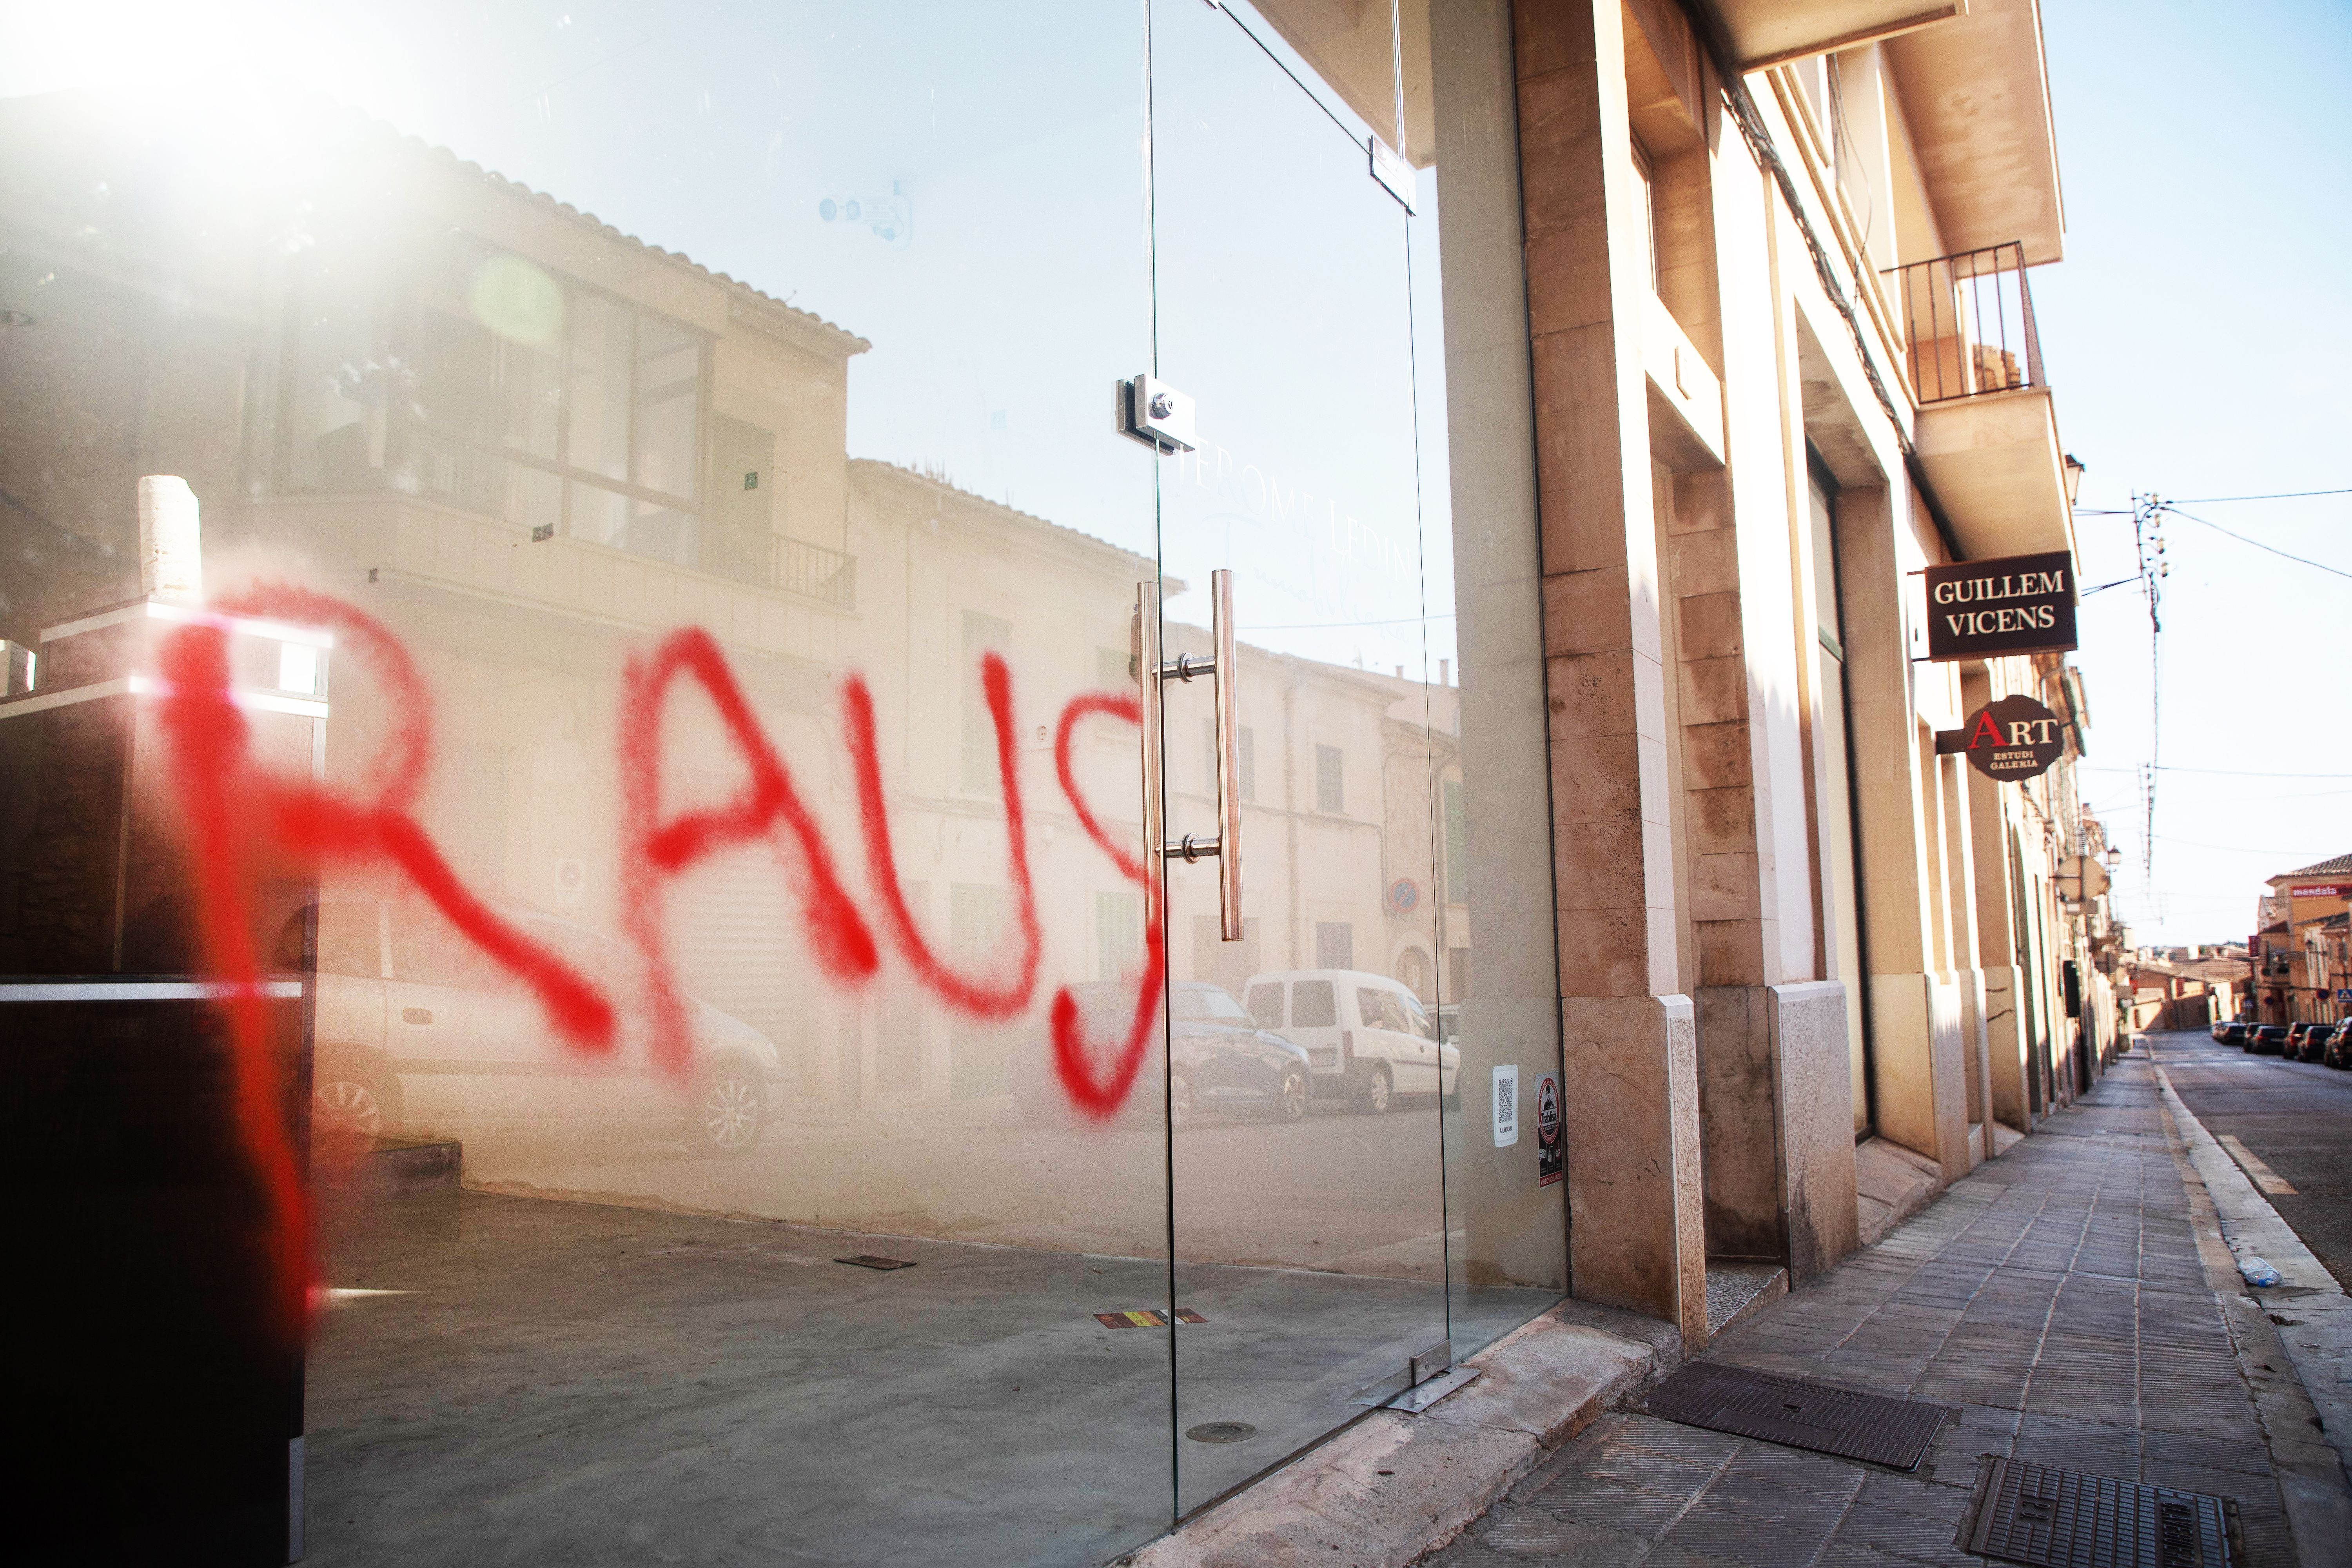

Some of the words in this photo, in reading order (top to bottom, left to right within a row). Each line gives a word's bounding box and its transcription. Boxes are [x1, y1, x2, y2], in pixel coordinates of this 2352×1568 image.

[1327, 497, 1412, 586] LEDIN
[1934, 570, 2065, 605] GUILLEM
[1945, 605, 2055, 637] VICENS
[1967, 711, 2058, 749] ART
[1990, 759, 2038, 770] GALERIA
[1993, 750, 2034, 760] ESTUDI
[157, 580, 1170, 1333] RAUS
[1541, 1110, 1557, 1124] Trablisa
[2162, 1501, 2195, 1568] CLAVEGUERA
